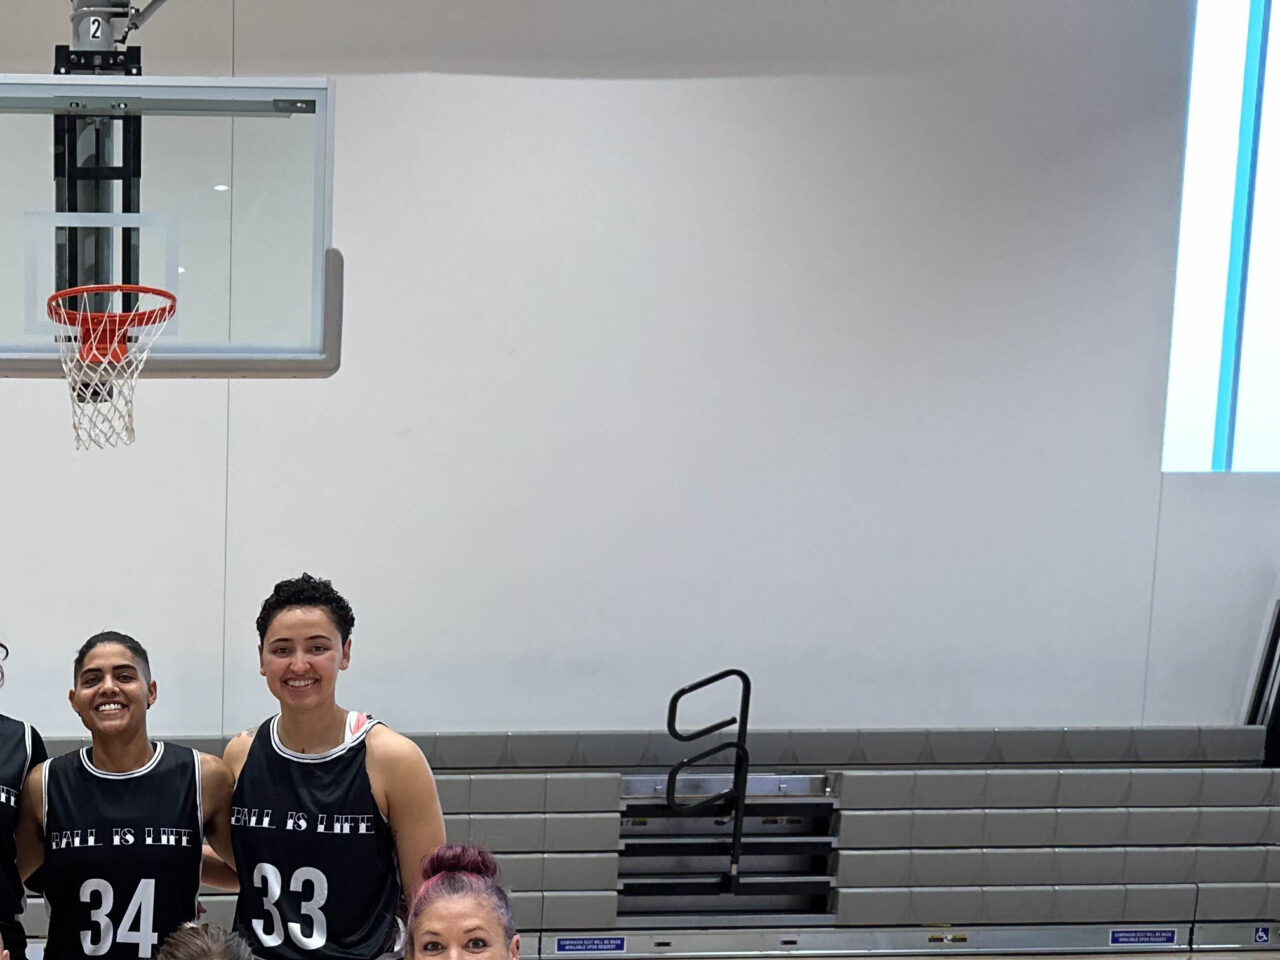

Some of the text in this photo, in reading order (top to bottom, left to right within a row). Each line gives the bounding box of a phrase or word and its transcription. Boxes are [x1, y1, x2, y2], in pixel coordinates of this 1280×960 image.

[91, 18, 101, 39] 2
[231, 806, 375, 834] BALL IS LIFE
[51, 827, 193, 850] BALL IS LIFE
[79, 878, 159, 959] 34
[251, 862, 329, 950] 33
